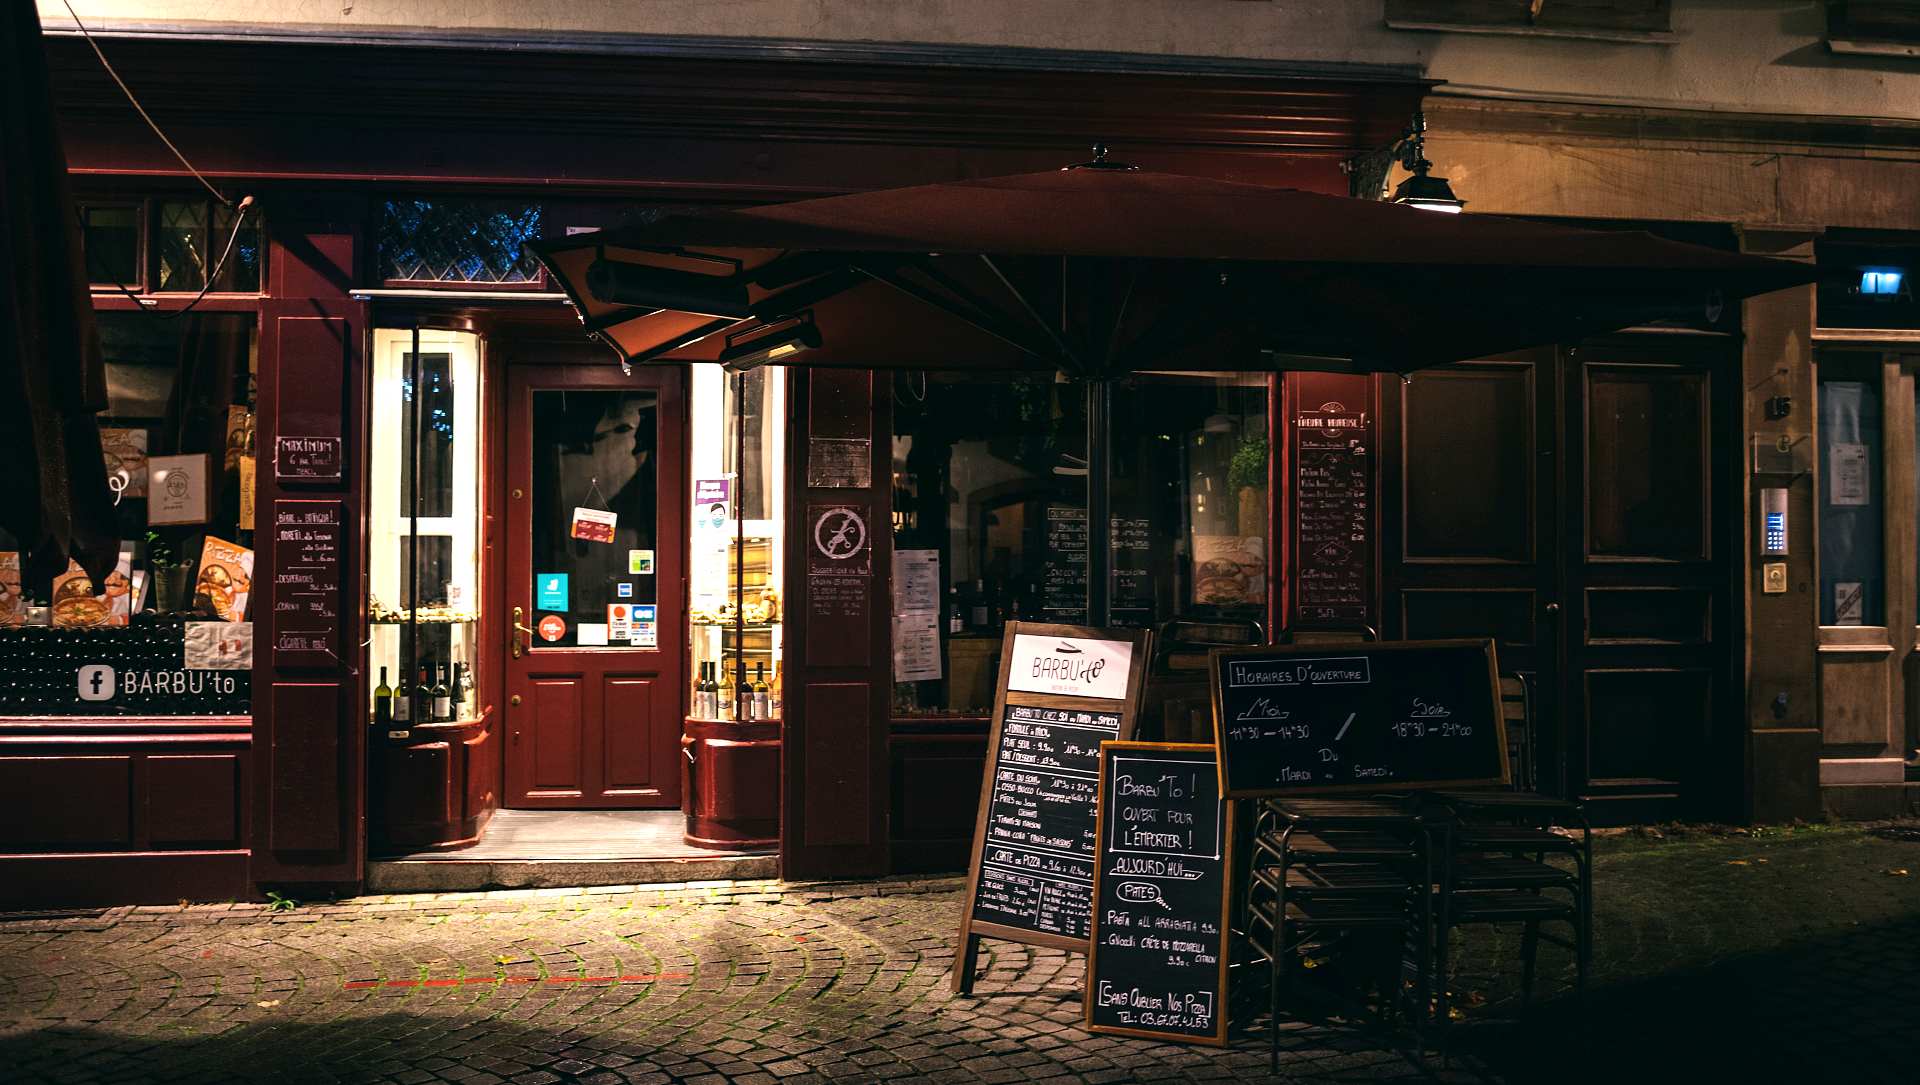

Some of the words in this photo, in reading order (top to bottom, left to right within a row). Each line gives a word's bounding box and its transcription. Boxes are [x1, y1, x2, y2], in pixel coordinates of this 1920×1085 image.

[281, 438, 333, 452] MAXIMUM
[123, 671, 237, 695] BARBU'to
[1236, 665, 1293, 684] HORAIRES
[1296, 664, 1362, 683] D'OUVERTURE
[1122, 806, 1160, 823] OUVERT
[1167, 809, 1193, 825] POUR
[1124, 824, 1184, 849] L'EMPORTER
[995, 849, 1014, 864] CARTE
[1022, 854, 1041, 868] PIZZA
[1107, 910, 1131, 926] PASTA
[1194, 953, 1217, 965] CITRON
[1130, 987, 1163, 1011] OUBLIER
[1167, 992, 1183, 1013] NOS
